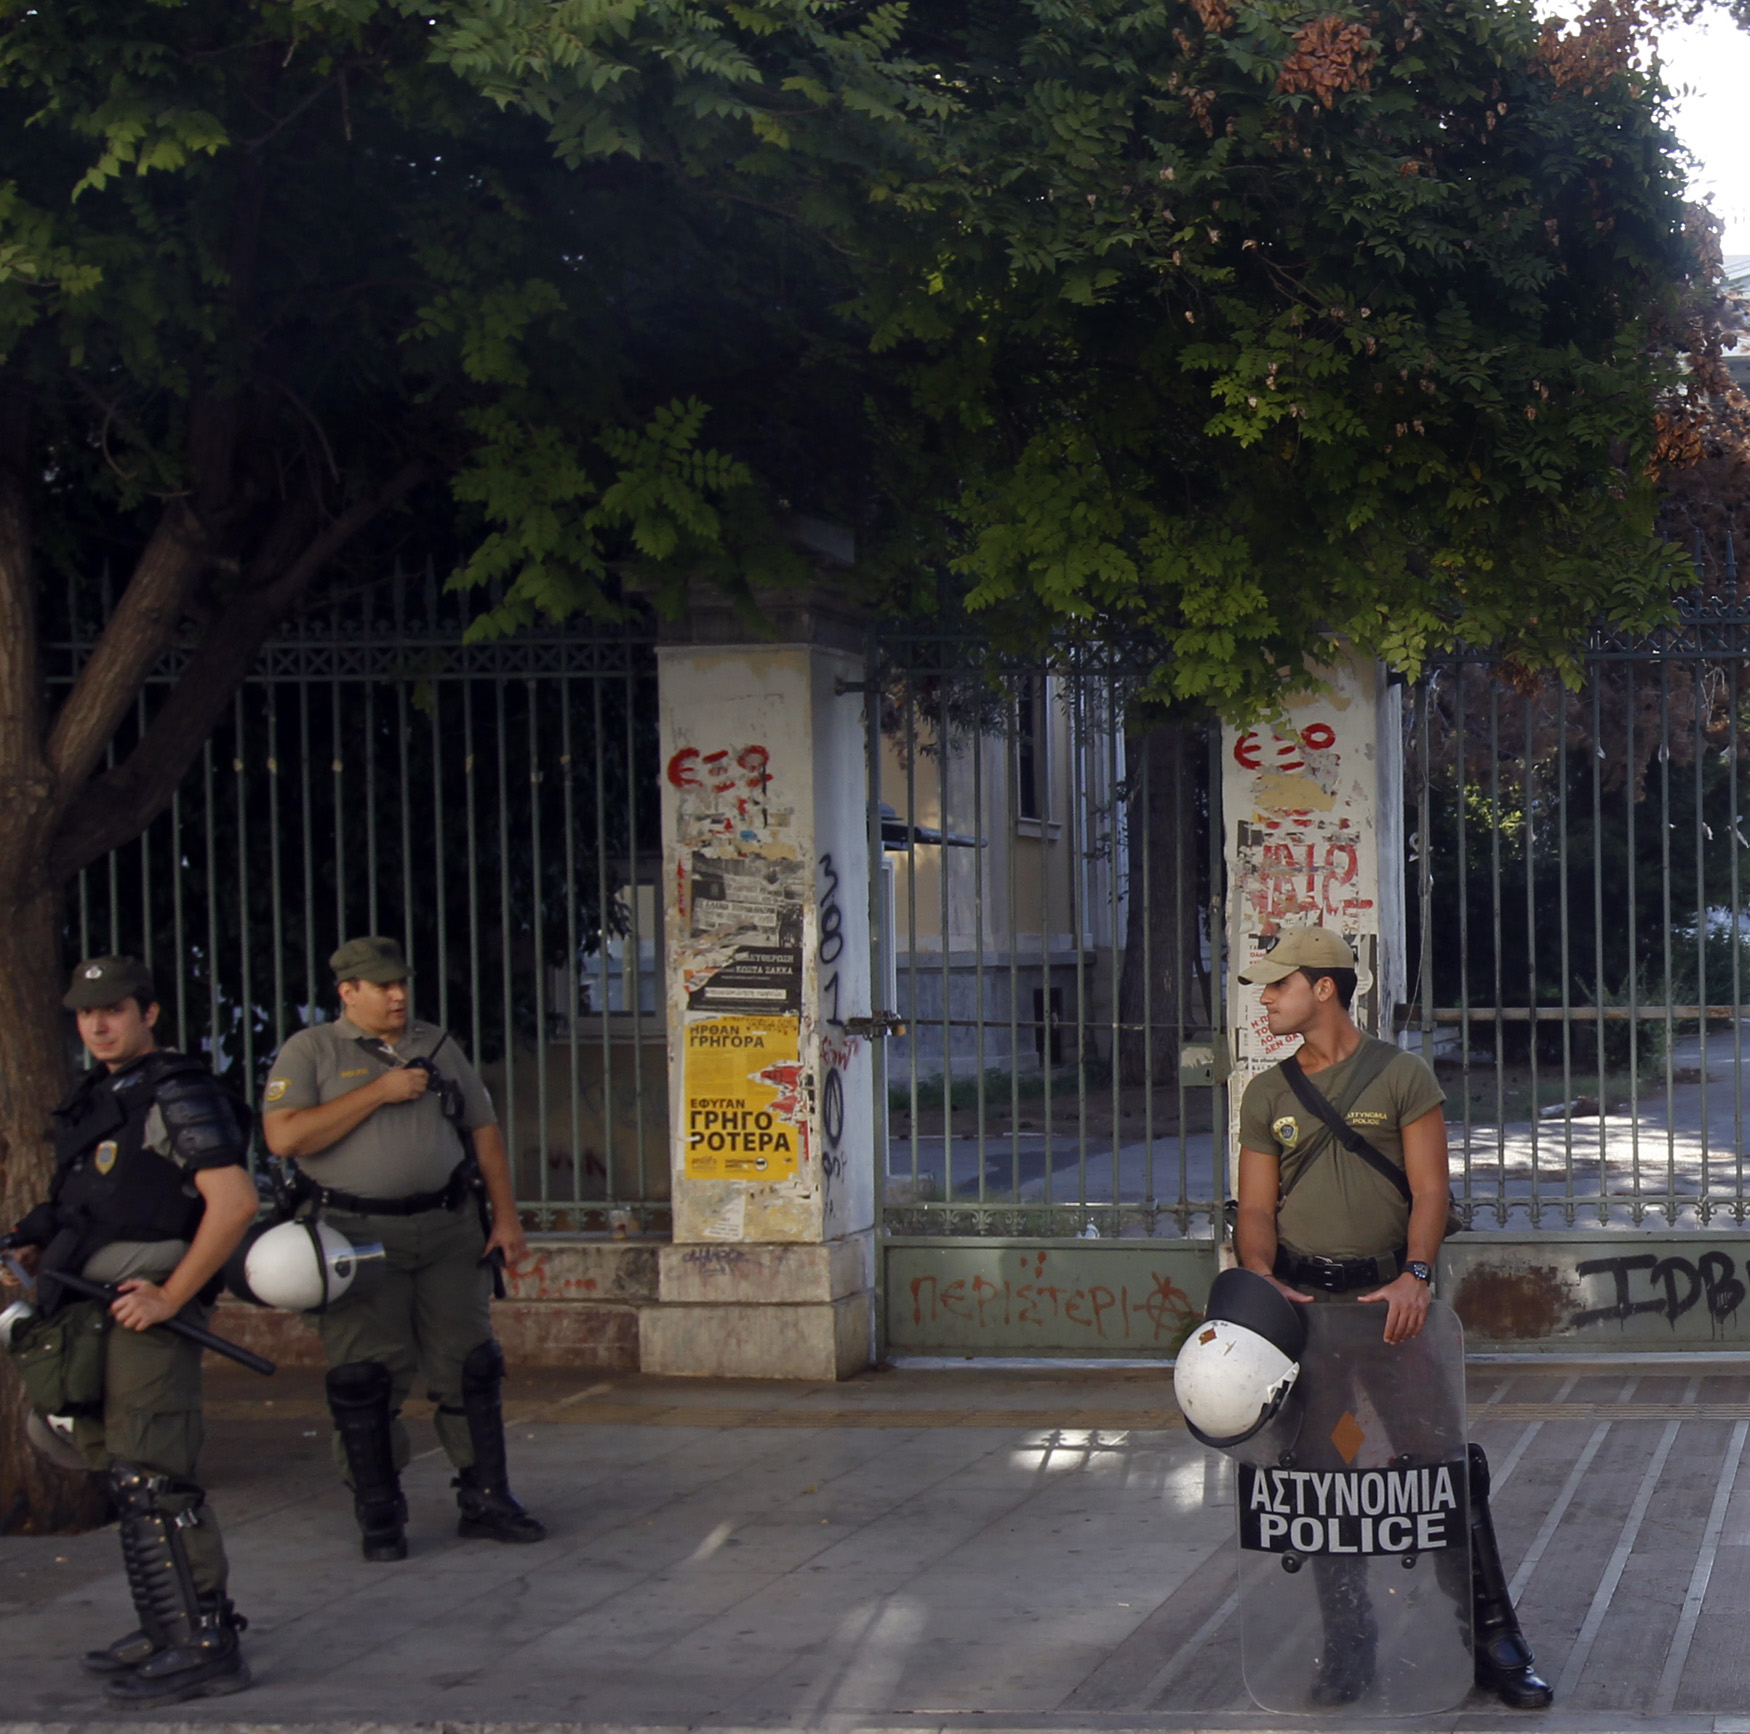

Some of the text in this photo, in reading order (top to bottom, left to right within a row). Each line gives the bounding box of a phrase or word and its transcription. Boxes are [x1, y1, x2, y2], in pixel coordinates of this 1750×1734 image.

[690, 1025, 740, 1035] ΗΡΘΑΝ
[1255, 1026, 1269, 1037] ΤΟ
[690, 1035, 765, 1048] ΓΡΗΓΟΡΑ
[1265, 1041, 1284, 1054] ΔΕΝ
[690, 1099, 745, 1109] ΕΦΥΓΑΝ
[690, 1111, 773, 1131] ΓΡΗΓΟ
[690, 1132, 791, 1152] ΡΟΤΕΡΑ
[1250, 1465, 1457, 1516] ΑΣΤΥΝΟΜΙΑ
[1259, 1512, 1448, 1553] POLICE
